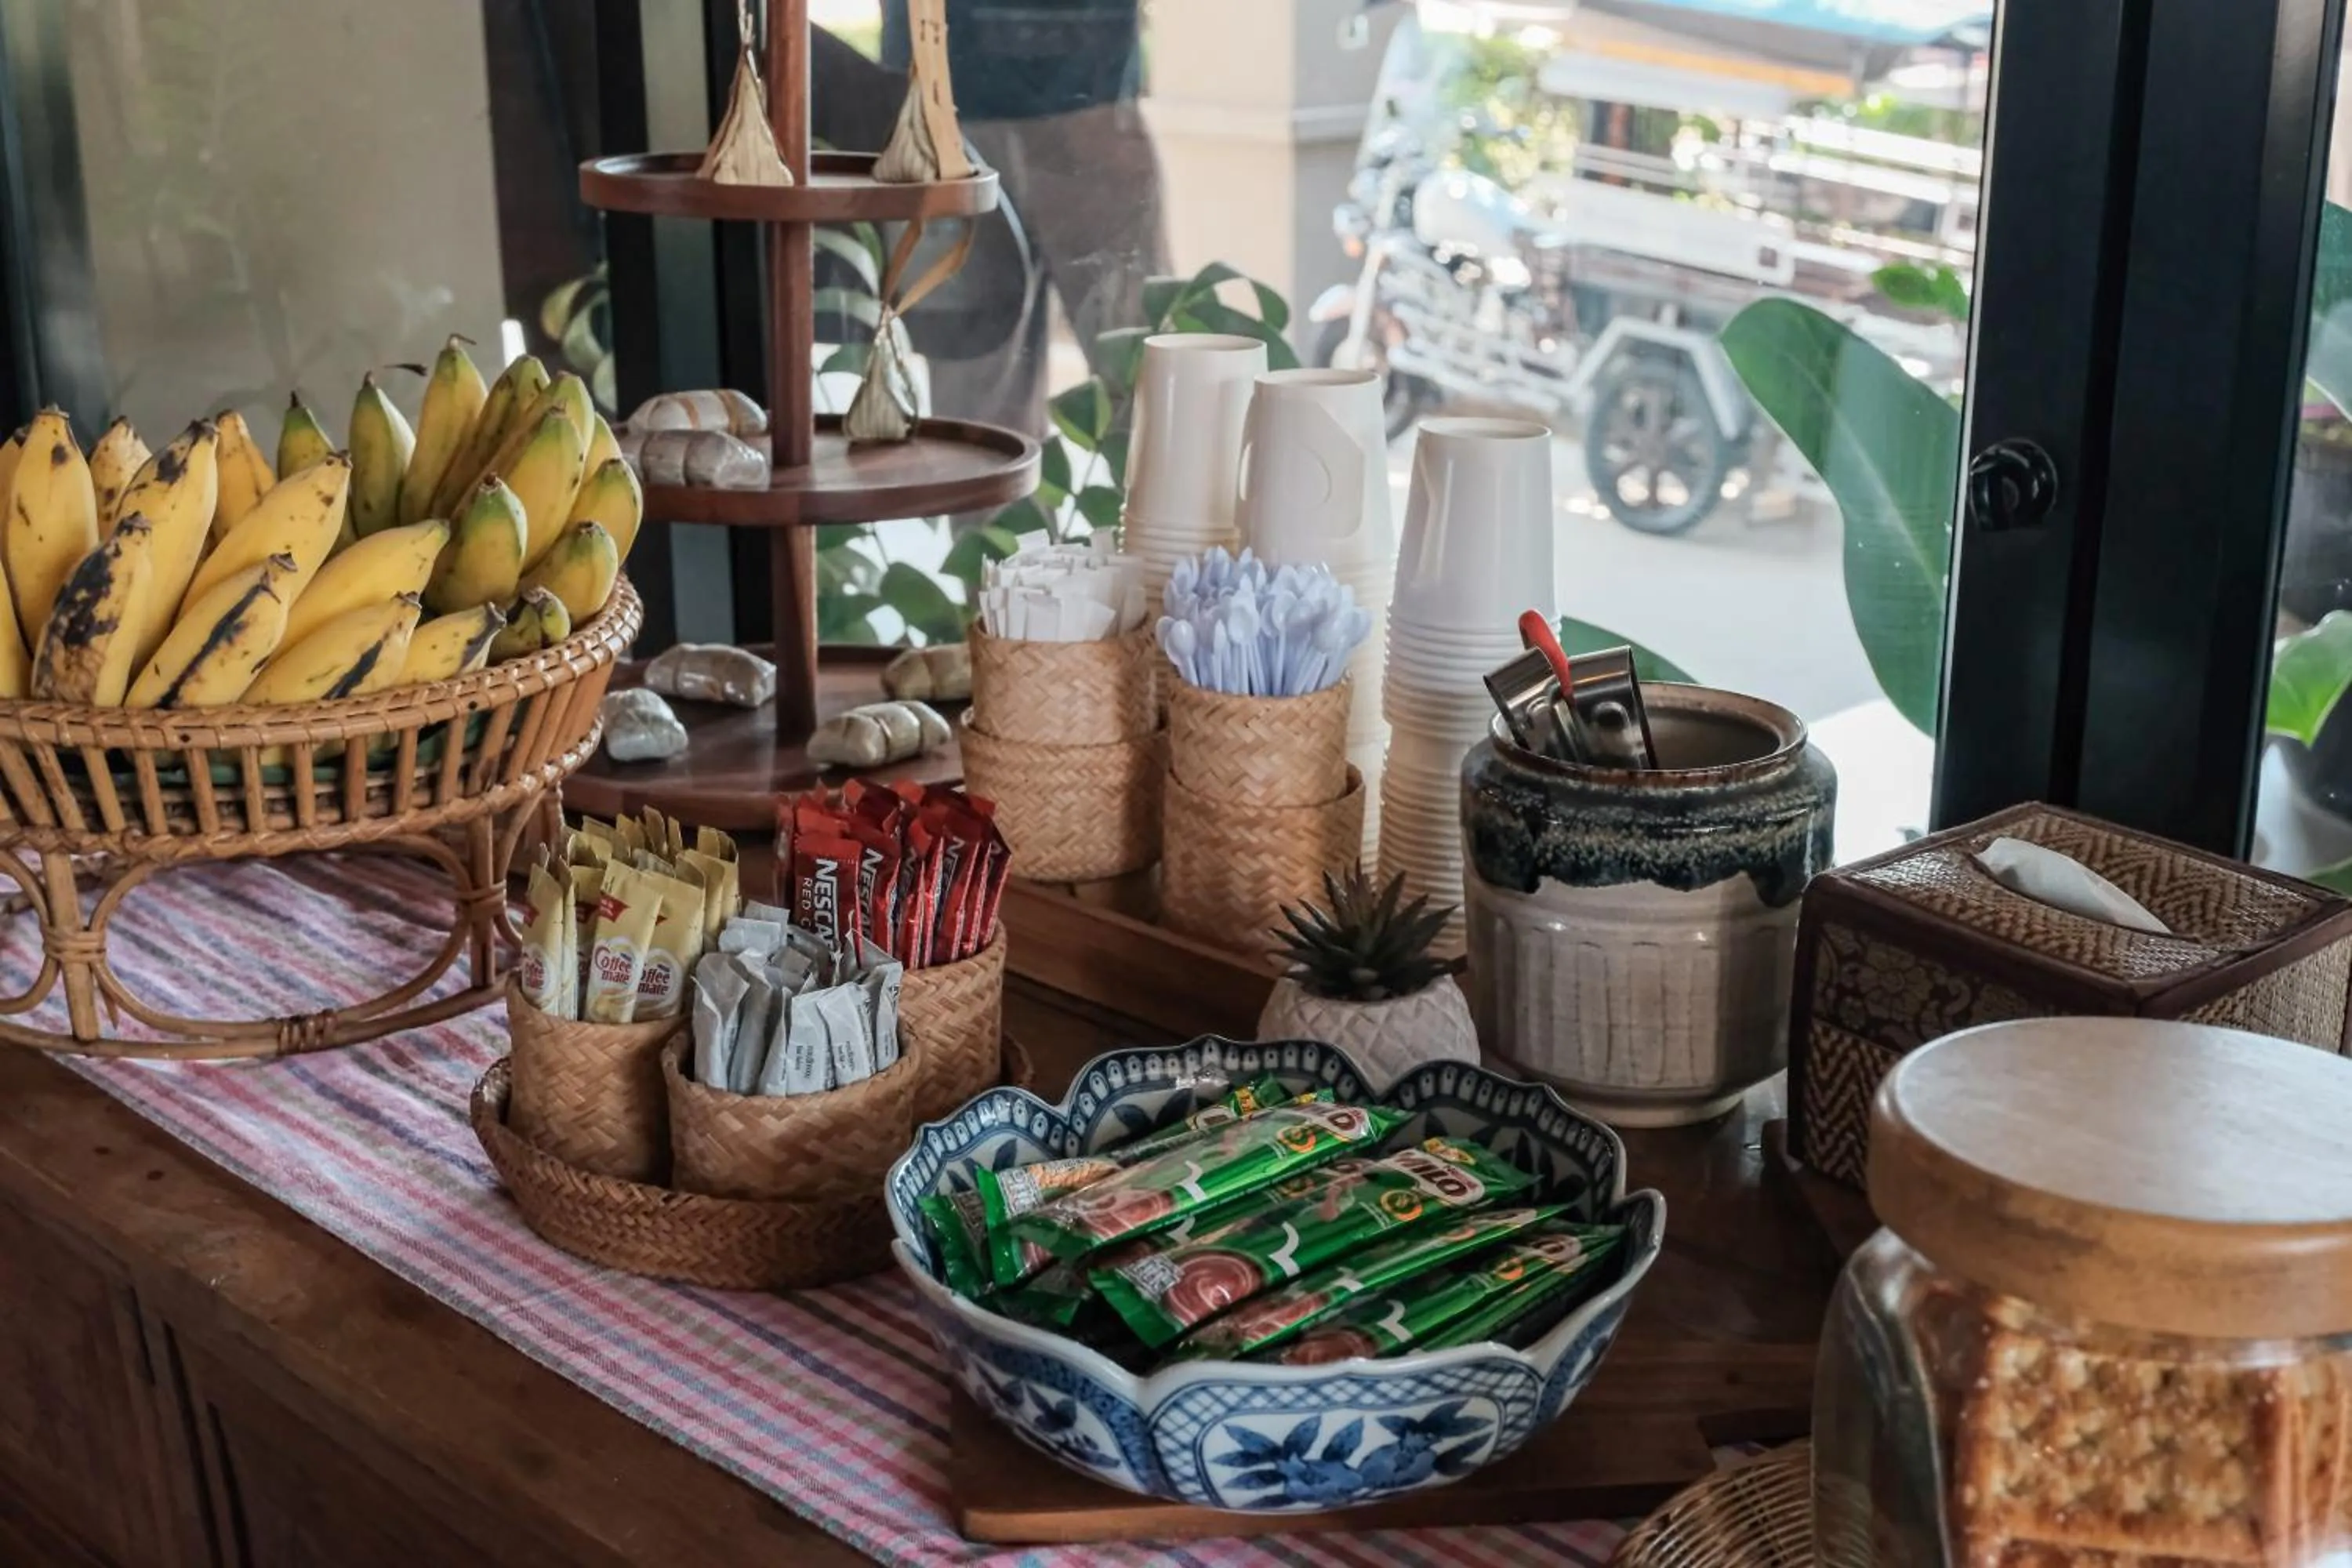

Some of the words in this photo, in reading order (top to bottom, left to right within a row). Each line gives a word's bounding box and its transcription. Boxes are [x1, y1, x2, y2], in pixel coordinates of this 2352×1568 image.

[801, 877, 813, 910] RED
[594, 946, 632, 974] Coffee
[601, 970, 630, 984] mate
[637, 982, 670, 996] mate
[1394, 1151, 1468, 1197] MILO
